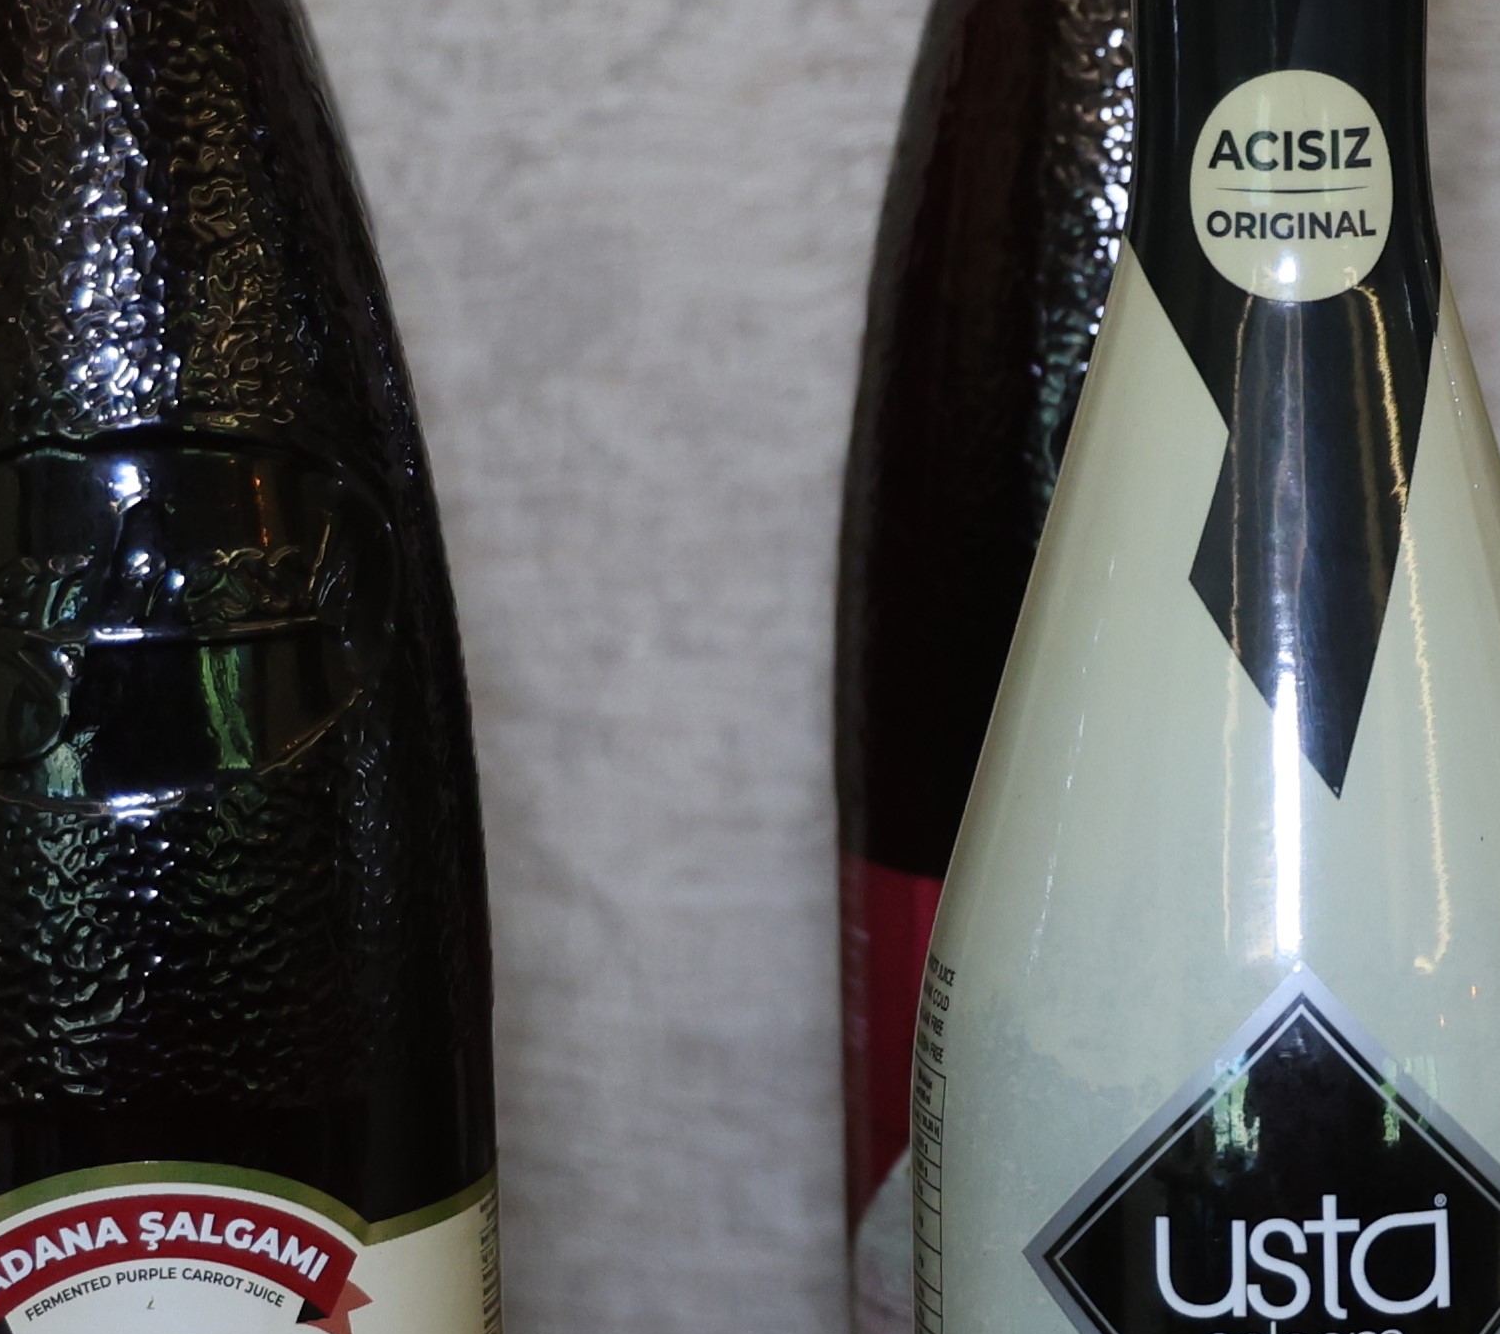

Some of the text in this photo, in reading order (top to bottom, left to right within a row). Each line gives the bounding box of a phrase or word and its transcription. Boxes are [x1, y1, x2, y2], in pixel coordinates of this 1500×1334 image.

[1208, 127, 1372, 171] ACISIZ
[1207, 209, 1376, 240] ORIGINAL
[139, 1211, 330, 1283] ŞALGAMI
[1155, 1193, 1452, 1321] usta
[25, 1267, 285, 1321] FERMENTED PURPLE CARROT JUICE
